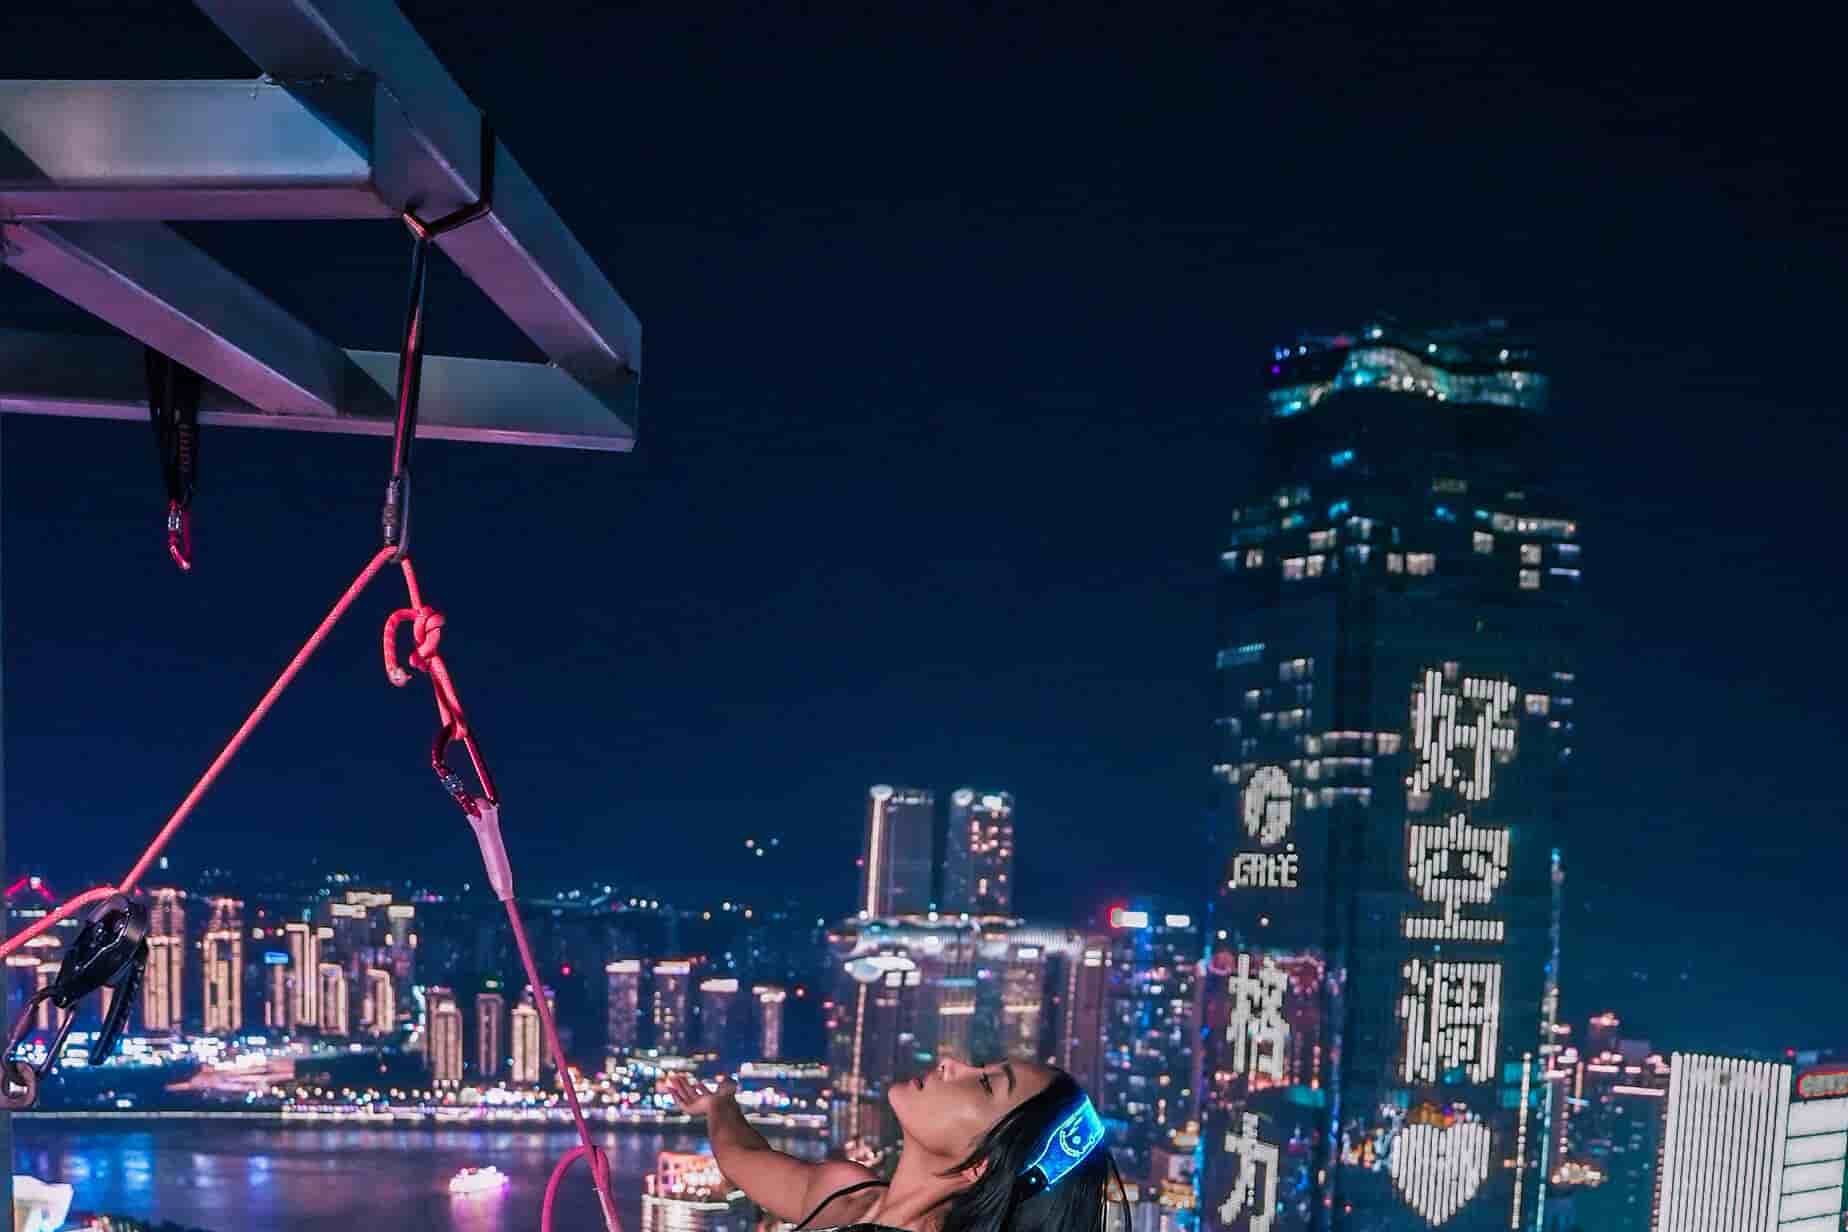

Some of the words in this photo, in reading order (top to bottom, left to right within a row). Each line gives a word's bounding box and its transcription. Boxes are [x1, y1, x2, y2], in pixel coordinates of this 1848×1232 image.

[1233, 853, 1298, 888] GREE
[1396, 667, 1517, 1084] 好空调
